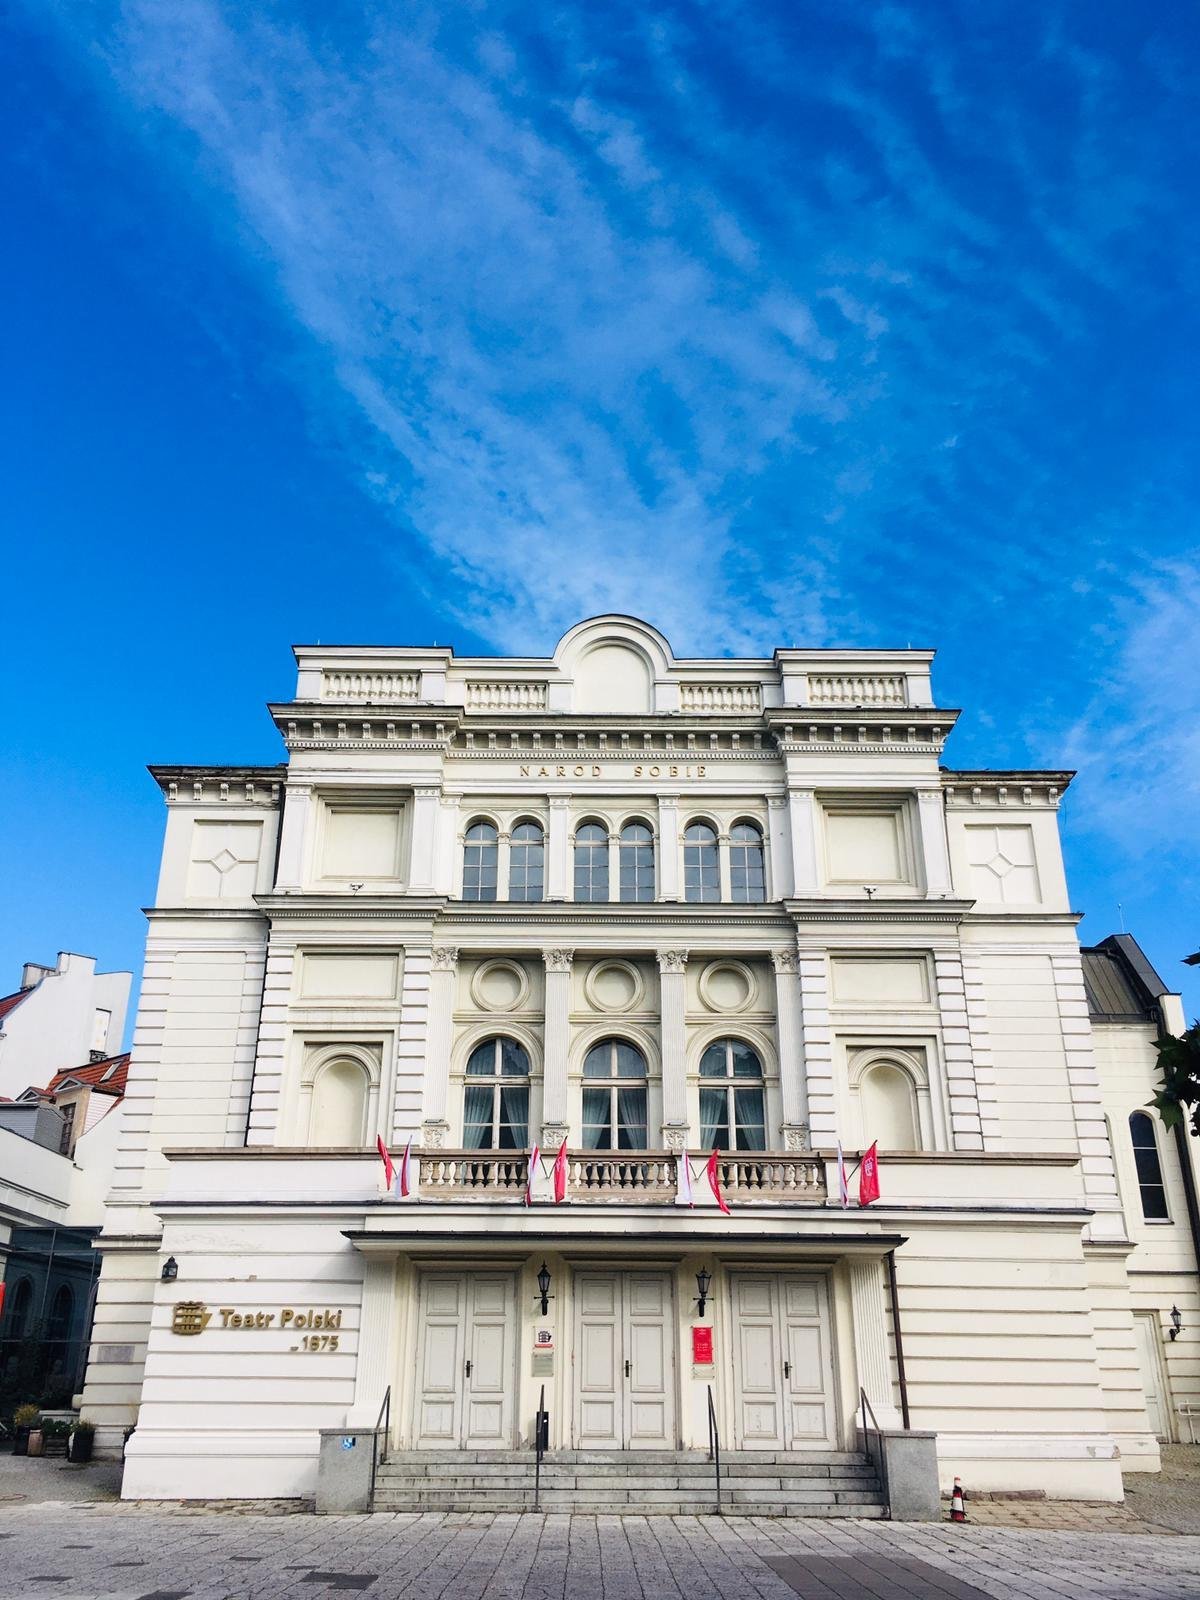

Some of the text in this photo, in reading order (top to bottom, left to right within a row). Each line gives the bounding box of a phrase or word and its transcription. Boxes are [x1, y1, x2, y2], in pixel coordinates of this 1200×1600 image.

[634, 766, 706, 778] SOBIE
[219, 1308, 342, 1328] Teatr Polski
